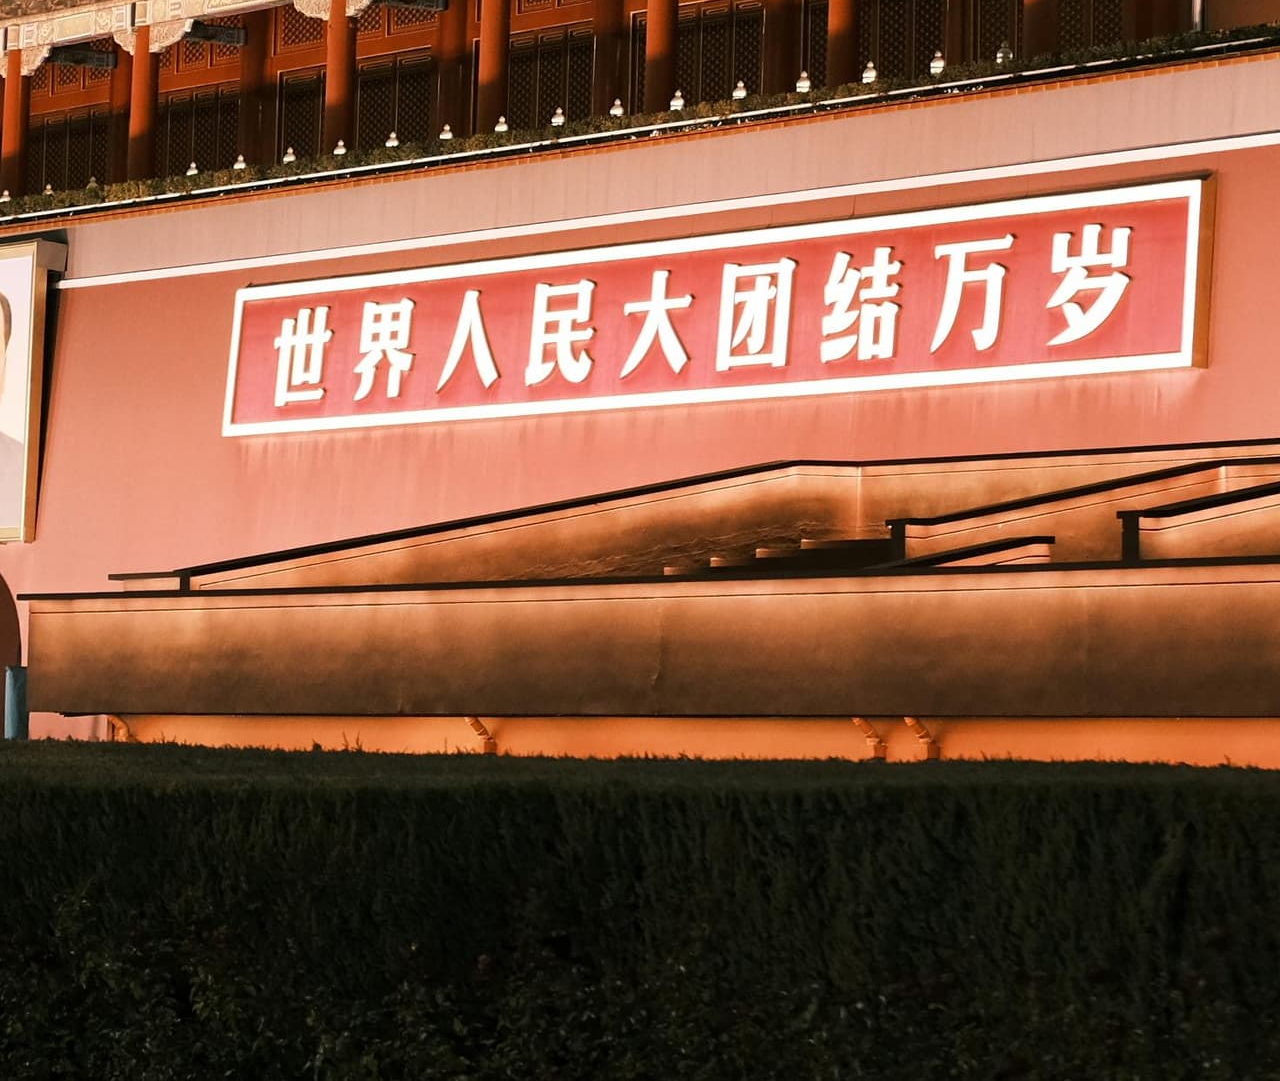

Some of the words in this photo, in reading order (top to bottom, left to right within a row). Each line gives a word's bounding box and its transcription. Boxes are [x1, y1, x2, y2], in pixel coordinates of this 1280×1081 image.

[274, 224, 1131, 407] 世界人民大团结万岁
